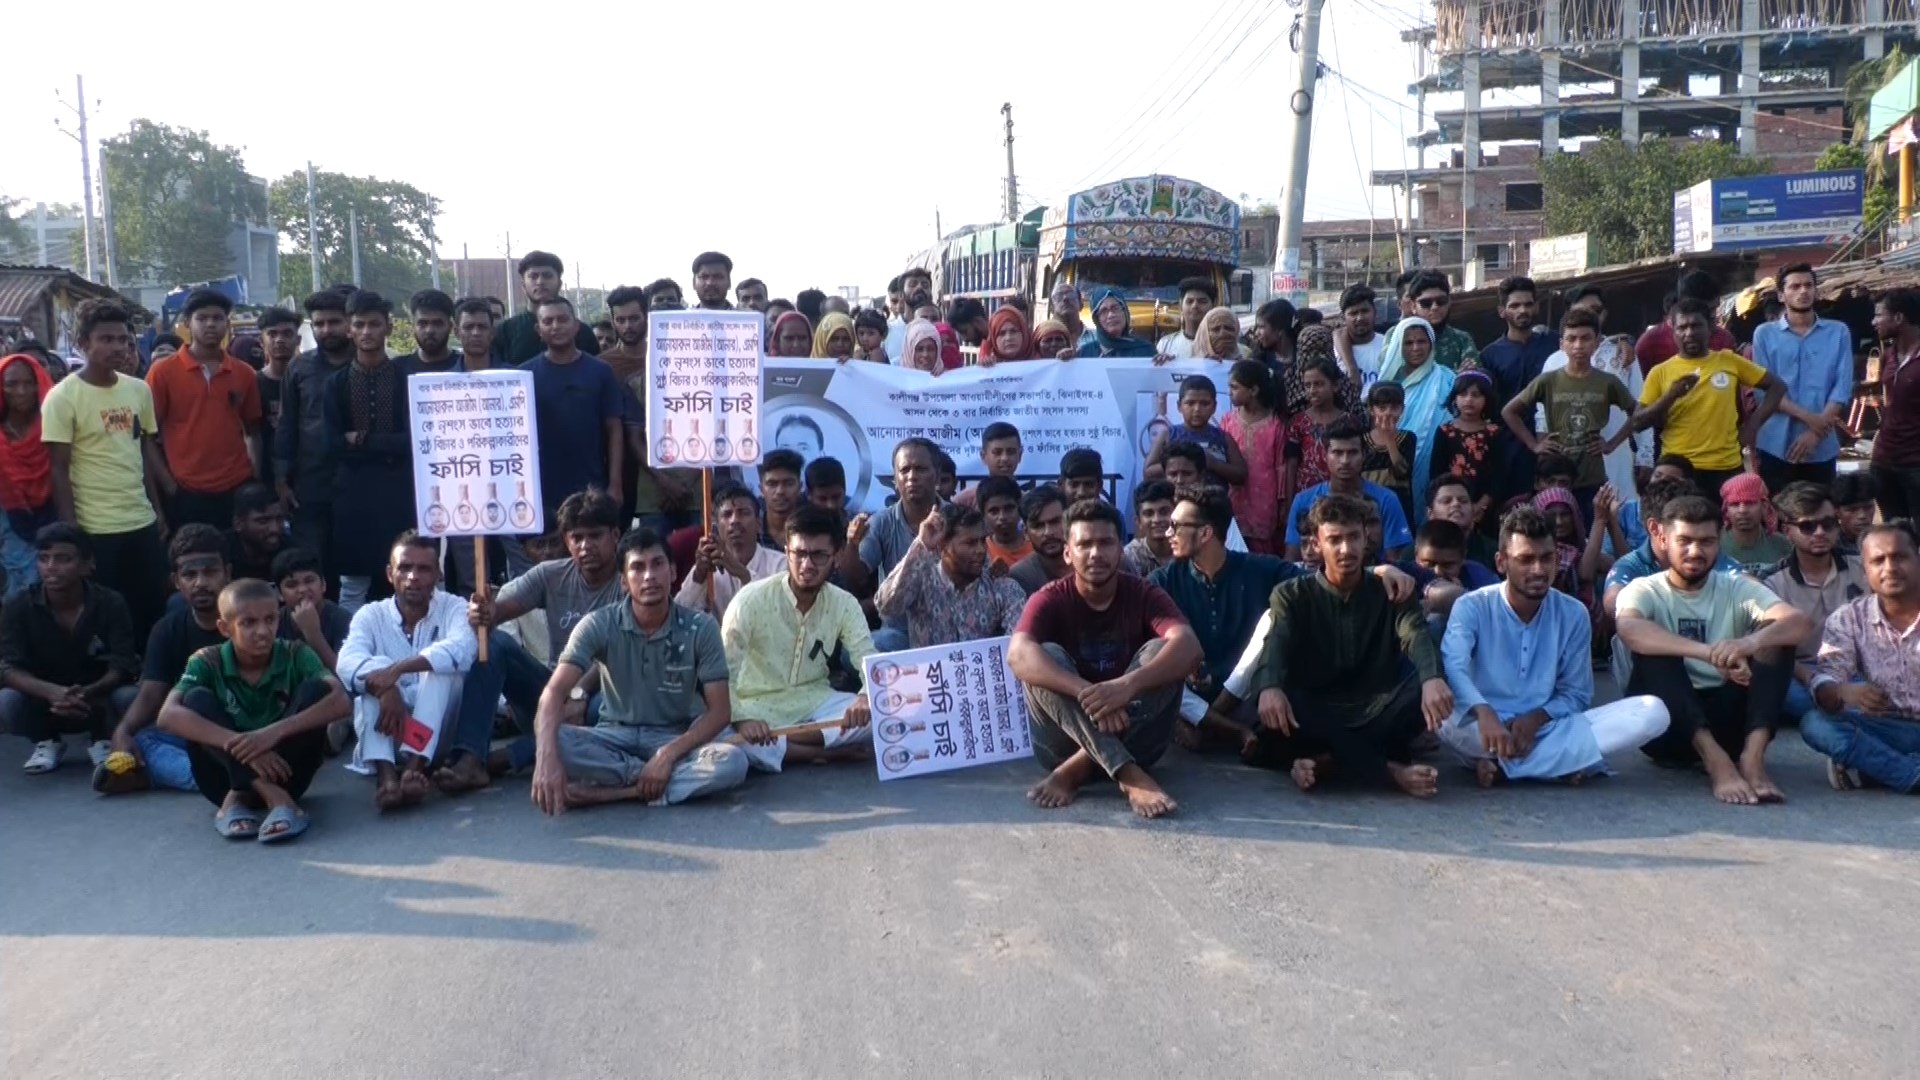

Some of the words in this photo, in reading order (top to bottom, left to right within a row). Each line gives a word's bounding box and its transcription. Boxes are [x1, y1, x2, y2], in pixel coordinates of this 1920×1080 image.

[1786, 176, 1856, 194] LUMINOUS
[659, 358, 671, 367] কে
[704, 357, 725, 368] ভাবে
[670, 372, 691, 386] বিচার
[692, 377, 698, 386] ও
[663, 391, 713, 413] ফাঁসি
[720, 393, 753, 415] চাই
[903, 408, 926, 417] আসন
[928, 408, 949, 418] থেকে
[952, 409, 960, 418] ৩
[963, 407, 976, 417] বার
[979, 405, 1010, 417] নির্বাচিত
[1013, 404, 1039, 416] জাতীয়
[1067, 406, 1089, 416] সদস্য
[422, 421, 434, 433] কে
[469, 417, 491, 431] ভাবে
[1044, 428, 1061, 438] ভাবে
[1063, 428, 1085, 438] হত্যার
[434, 435, 456, 451] বিচার
[459, 439, 464, 449] ও
[429, 454, 481, 478] ফাঁসি
[488, 454, 524, 476] চাই
[954, 664, 969, 687] বিচার
[926, 660, 953, 714] ফাঁসি
[972, 652, 983, 664] কে
[978, 698, 990, 721] ভাবে
[933, 721, 957, 758] চাই
